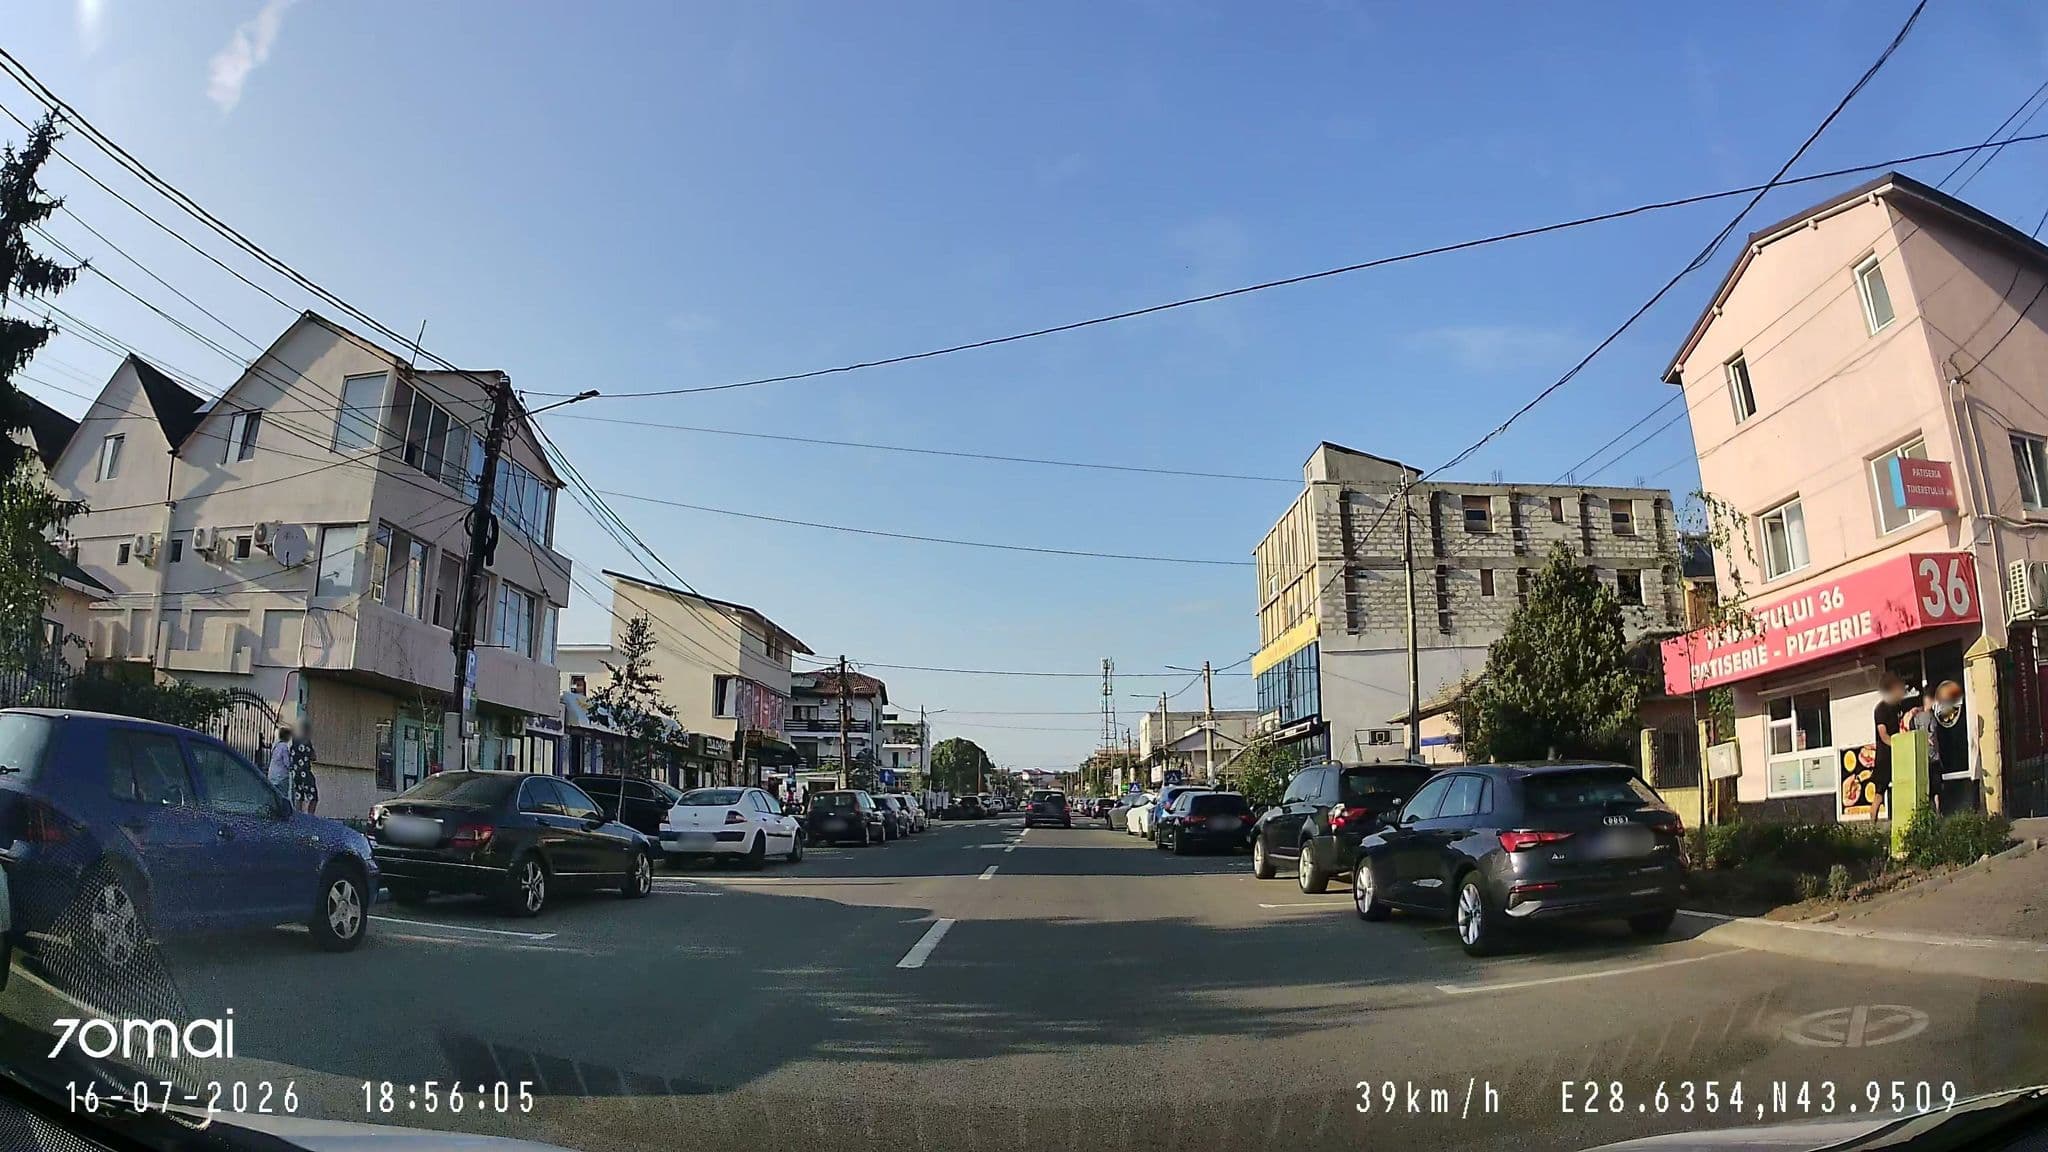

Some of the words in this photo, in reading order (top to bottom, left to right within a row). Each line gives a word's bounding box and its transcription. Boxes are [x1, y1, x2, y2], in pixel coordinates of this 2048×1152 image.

[1818, 585, 1846, 613] 36
[1919, 557, 1971, 618] 36
[1690, 644, 1768, 683] PATISERIE
[1785, 611, 1872, 657] PIZZERIE
